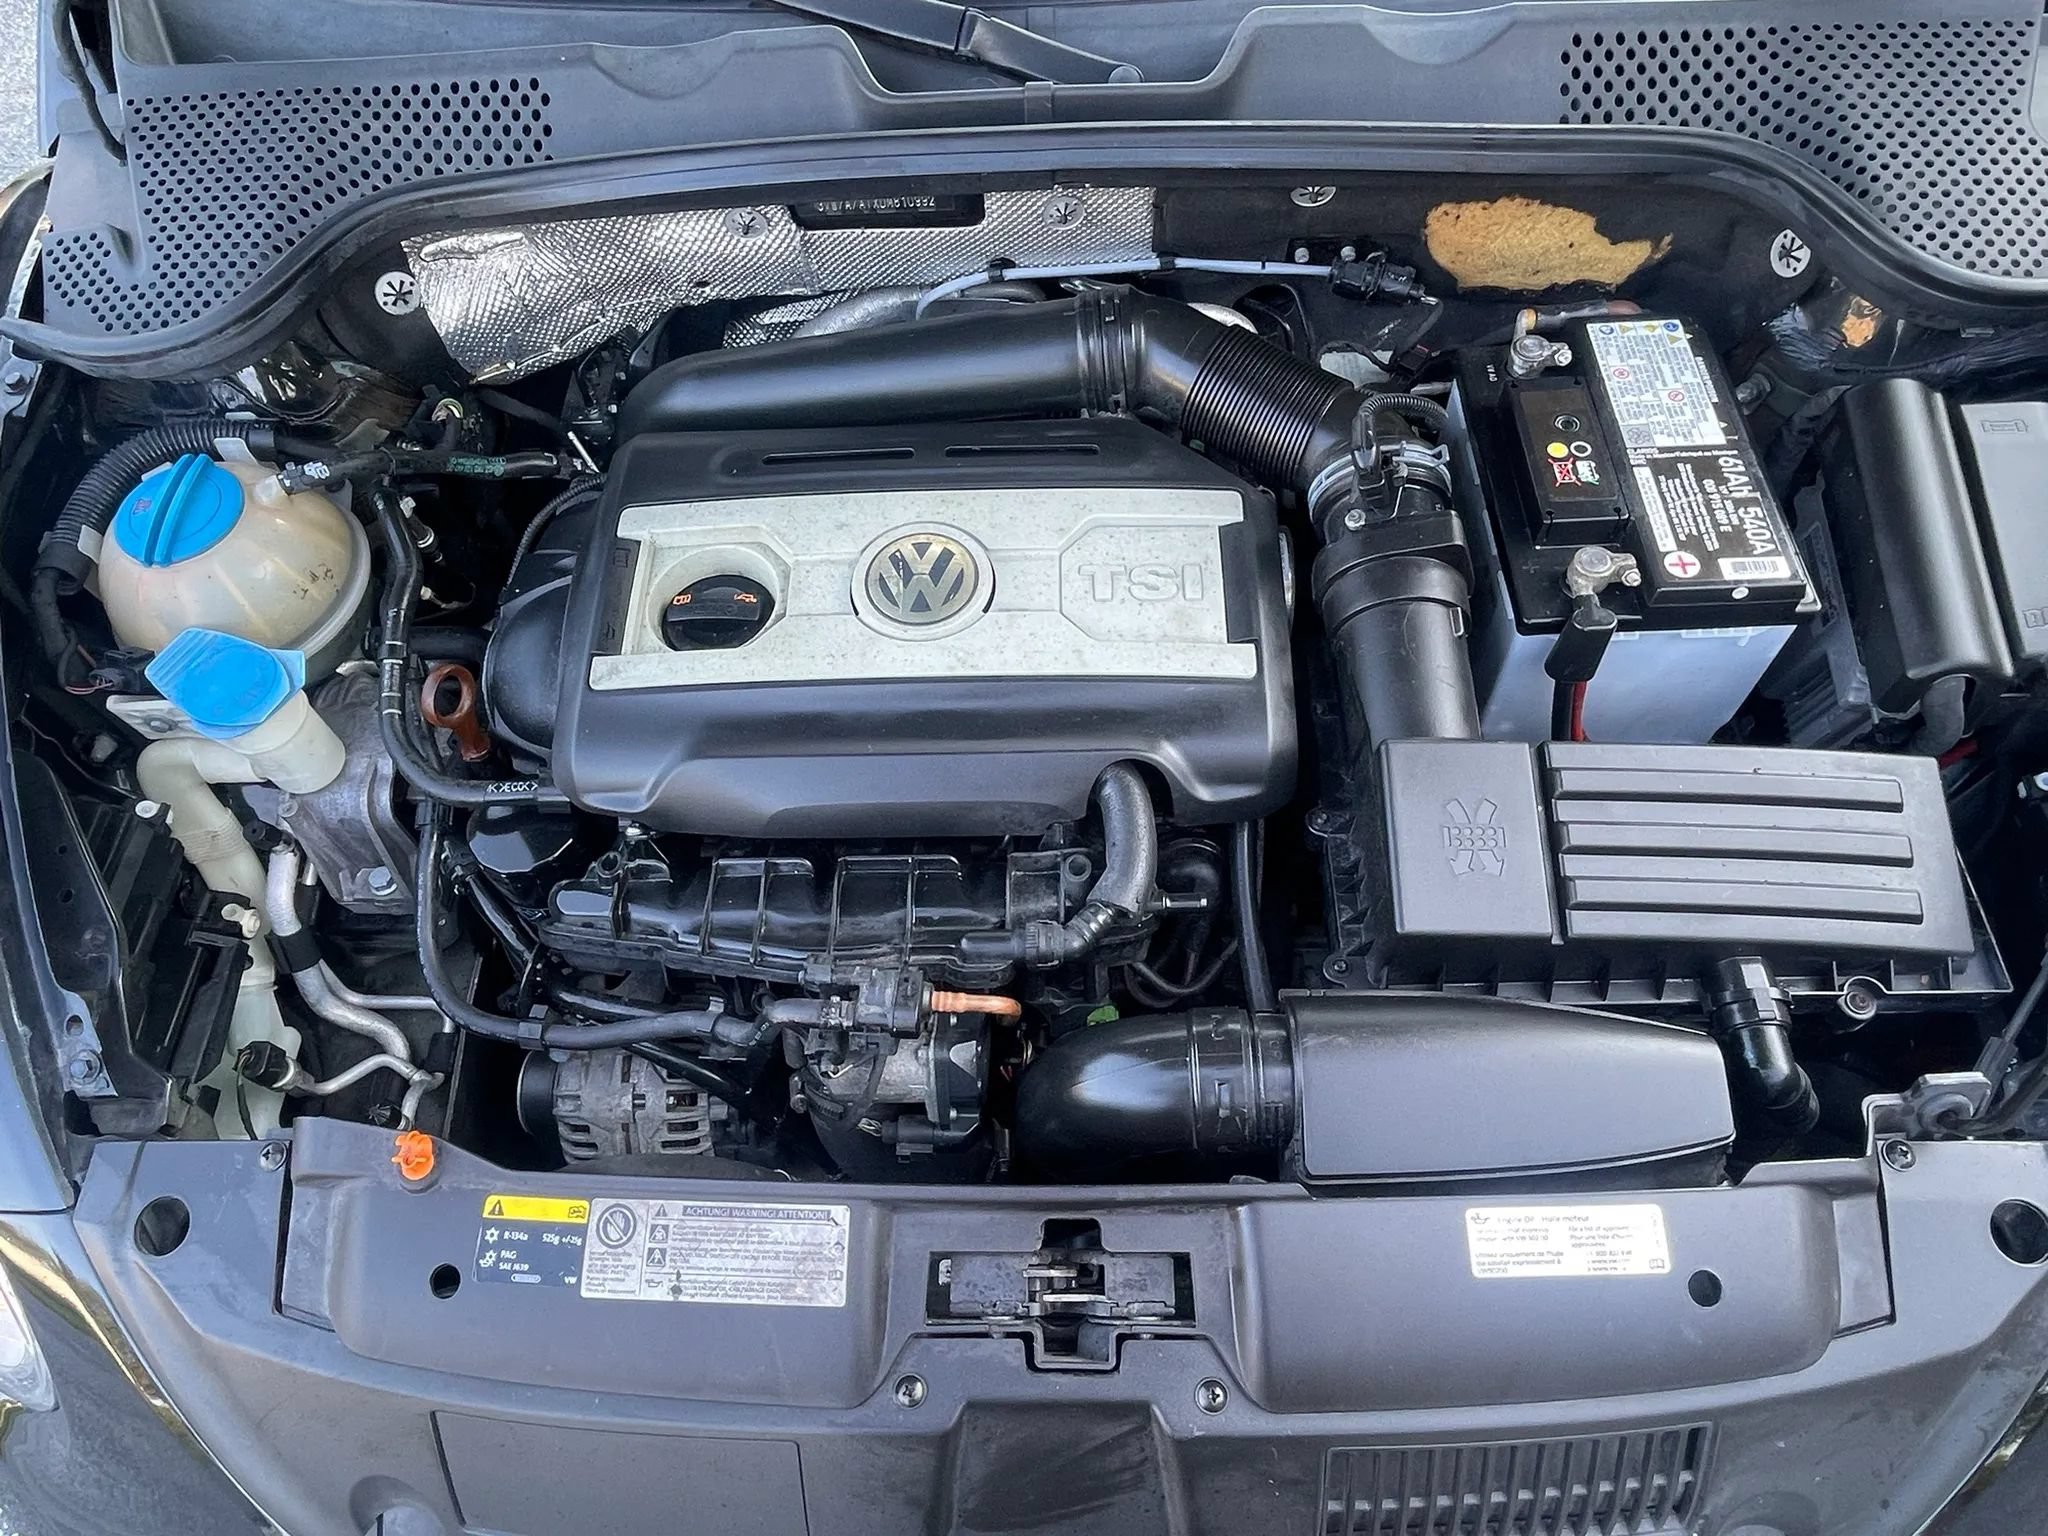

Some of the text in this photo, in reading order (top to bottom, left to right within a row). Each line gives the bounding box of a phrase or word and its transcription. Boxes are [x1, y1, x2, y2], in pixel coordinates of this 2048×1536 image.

[1738, 506, 1776, 556] 540A
[1077, 562, 1205, 602] TSI
[685, 1207, 828, 1220] ACHTUNG! WARNING! ATTENTION!
[503, 1230, 529, 1241] R-134a
[541, 1232, 560, 1246] 525g
[500, 1249, 517, 1259] PAG
[498, 1261, 530, 1271] SAE J639
[564, 1275, 578, 1285] VW
